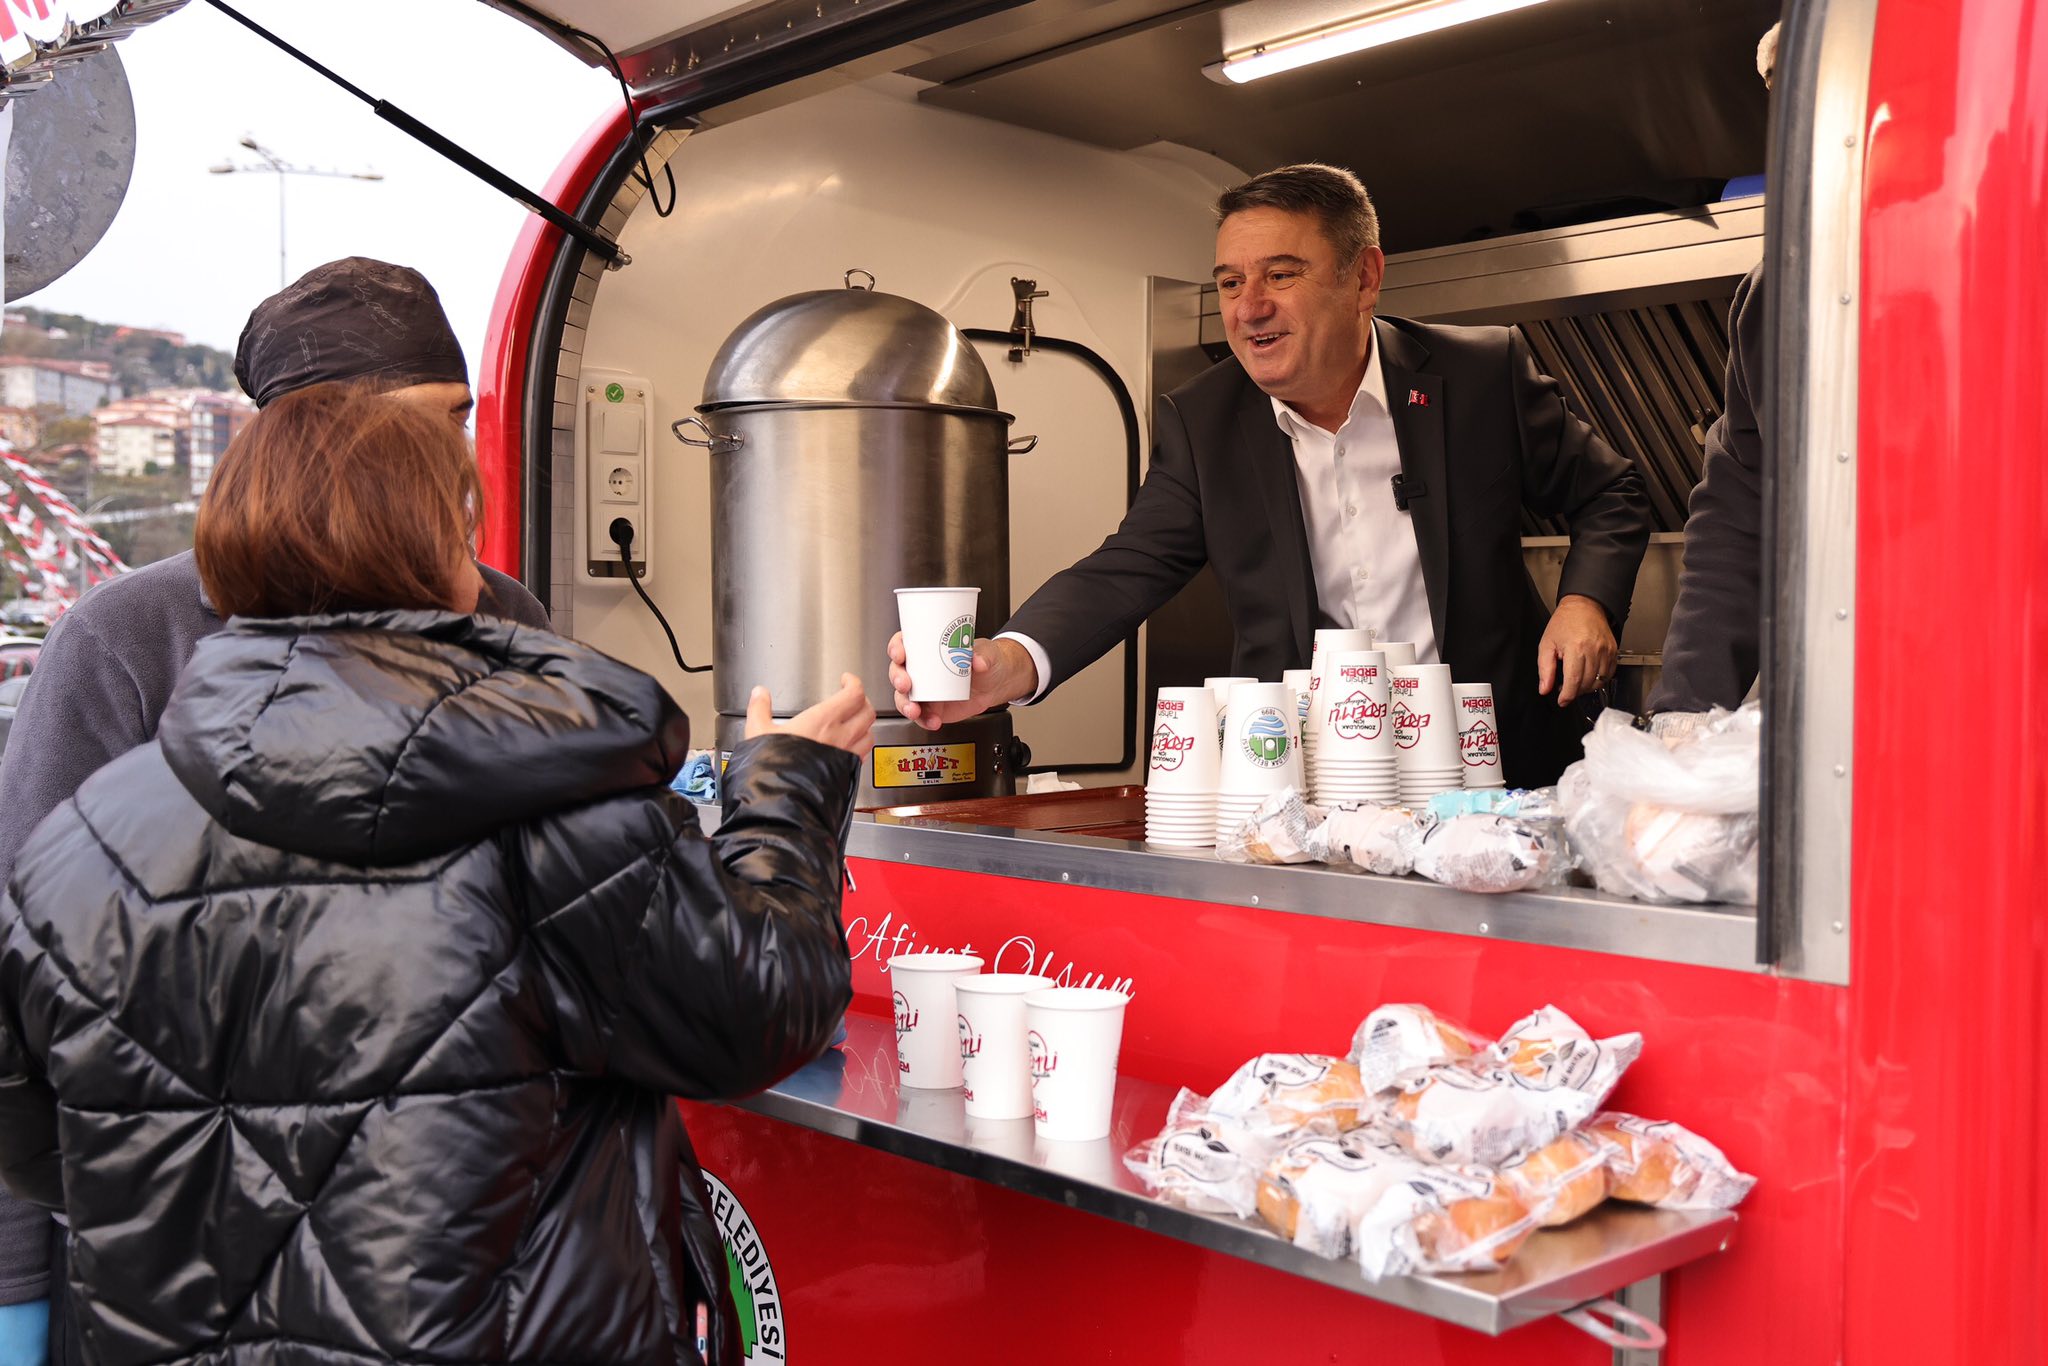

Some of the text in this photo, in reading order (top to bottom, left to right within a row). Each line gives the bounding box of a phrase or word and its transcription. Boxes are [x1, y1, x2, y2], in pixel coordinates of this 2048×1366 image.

[942, 617, 968, 646] ZONGULDAK
[1341, 668, 1378, 677] ERDEM
[1346, 676, 1374, 685] Tahsin
[1393, 688, 1414, 697] Tahs
[1462, 699, 1492, 708] ERDEM
[1158, 711, 1179, 719] Tahs
[1392, 713, 1431, 730] ERDE
[1153, 735, 1195, 751] ERDEM
